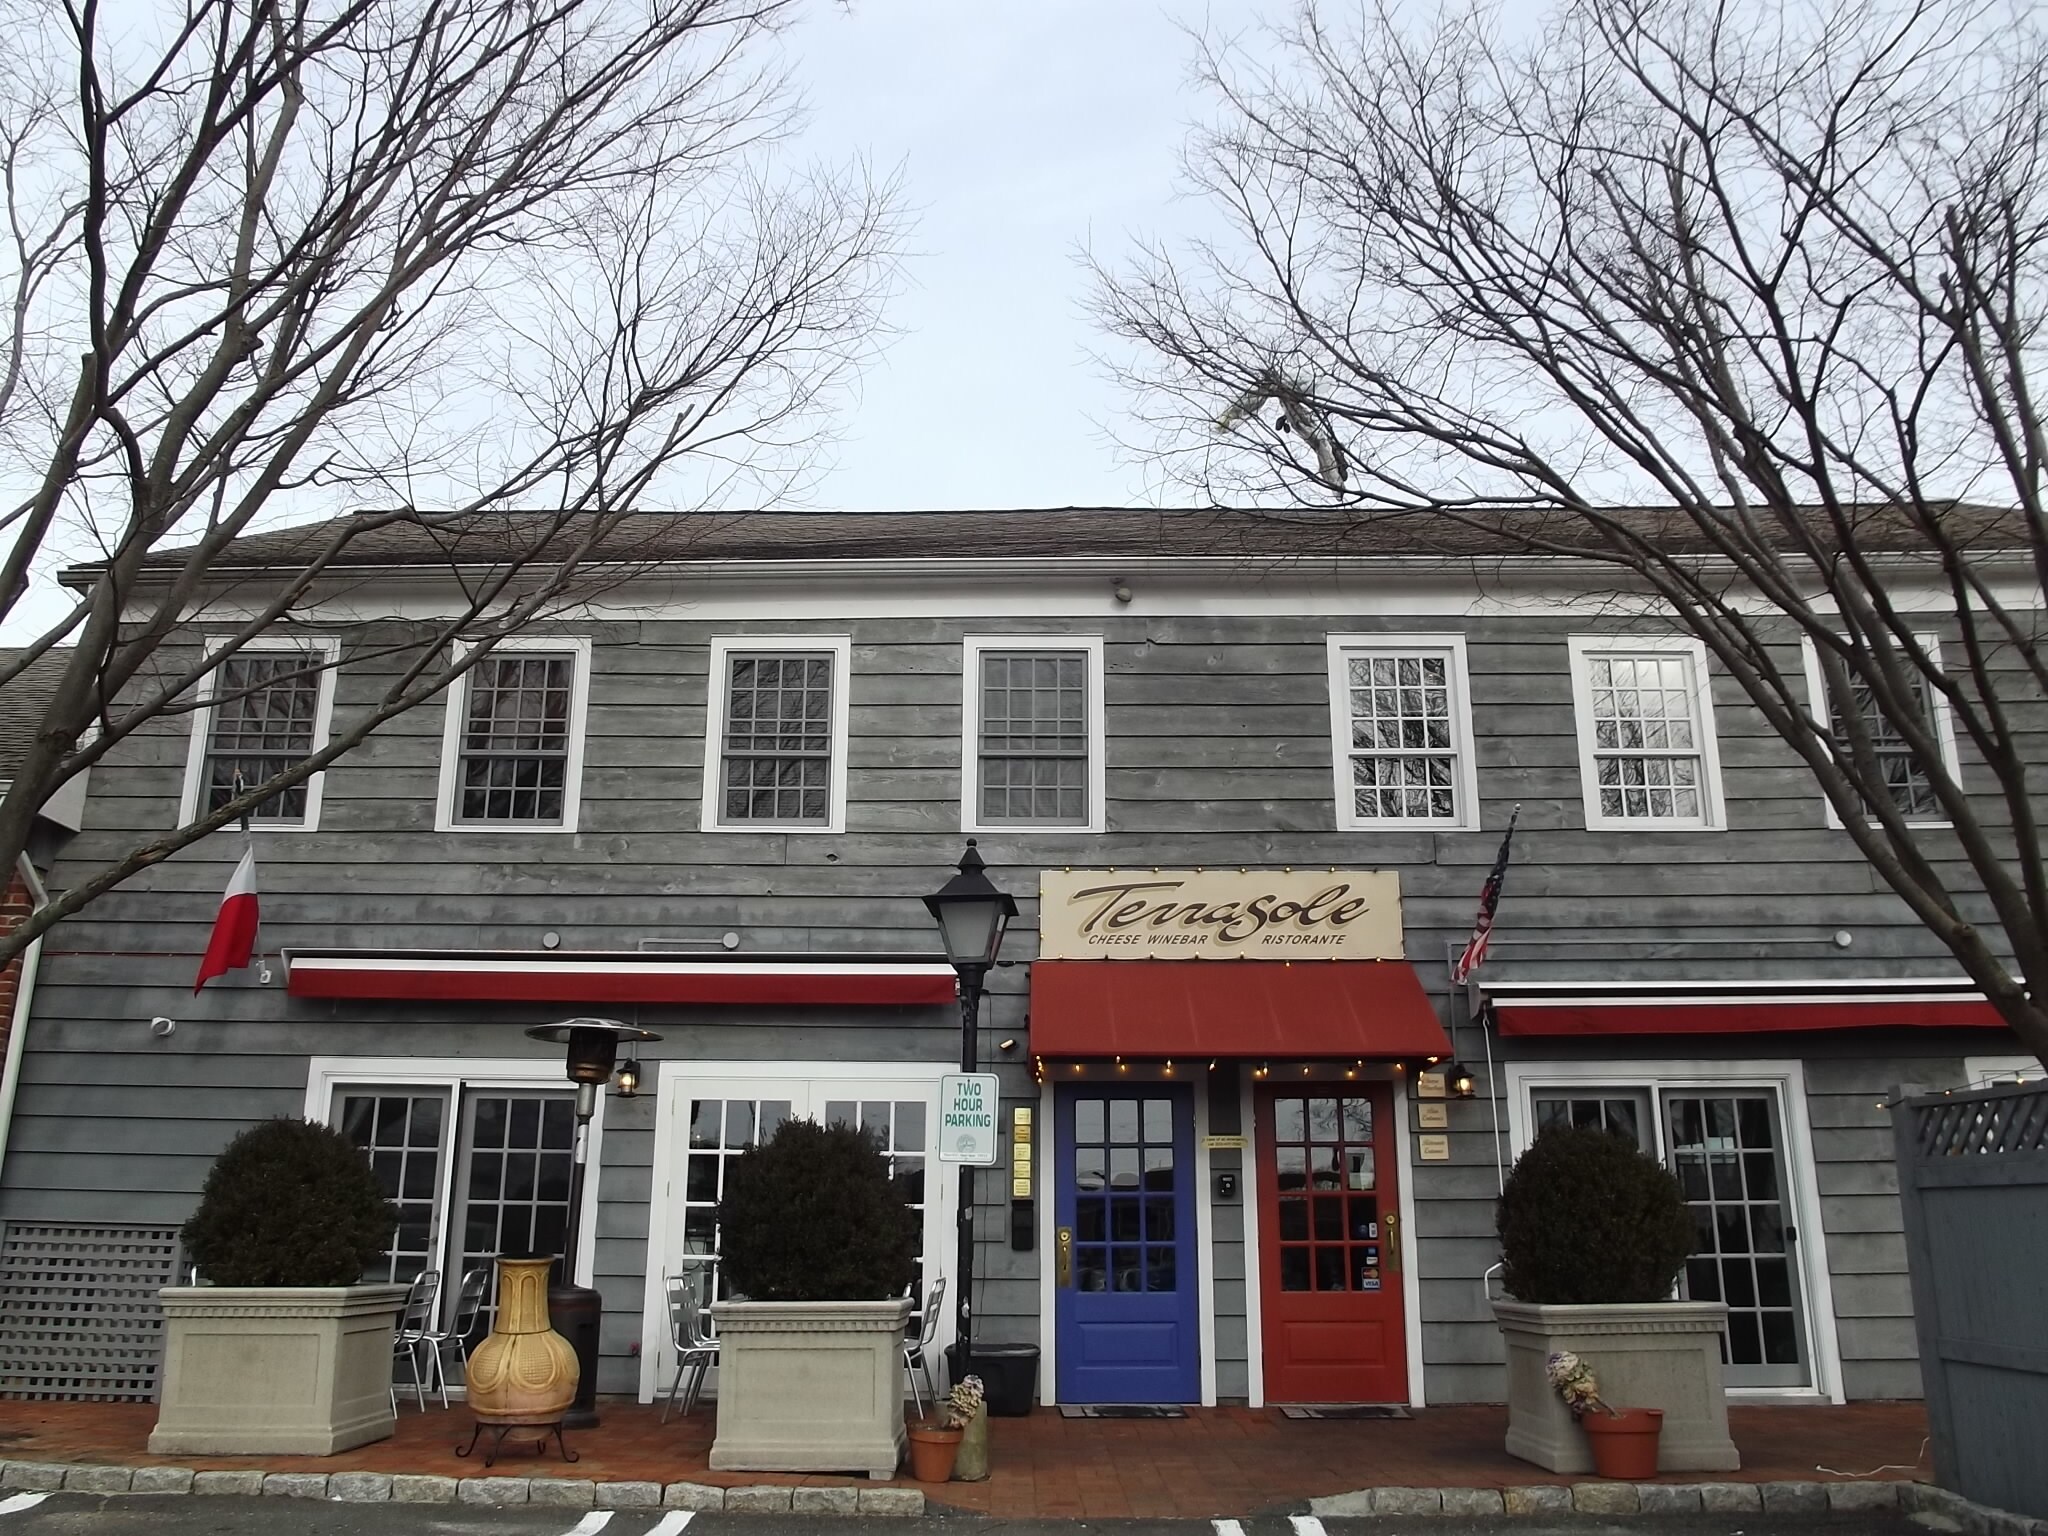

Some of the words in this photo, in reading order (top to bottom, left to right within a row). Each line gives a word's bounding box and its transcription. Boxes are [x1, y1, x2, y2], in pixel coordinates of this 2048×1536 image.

[1088, 934, 1142, 945] CHEESE
[1147, 934, 1209, 945] WINEBAR
[1261, 934, 1347, 945] RISTORANTE
[957, 1082, 982, 1096] TWO
[953, 1098, 983, 1112] HOUR
[944, 1113, 991, 1128] PARKING
